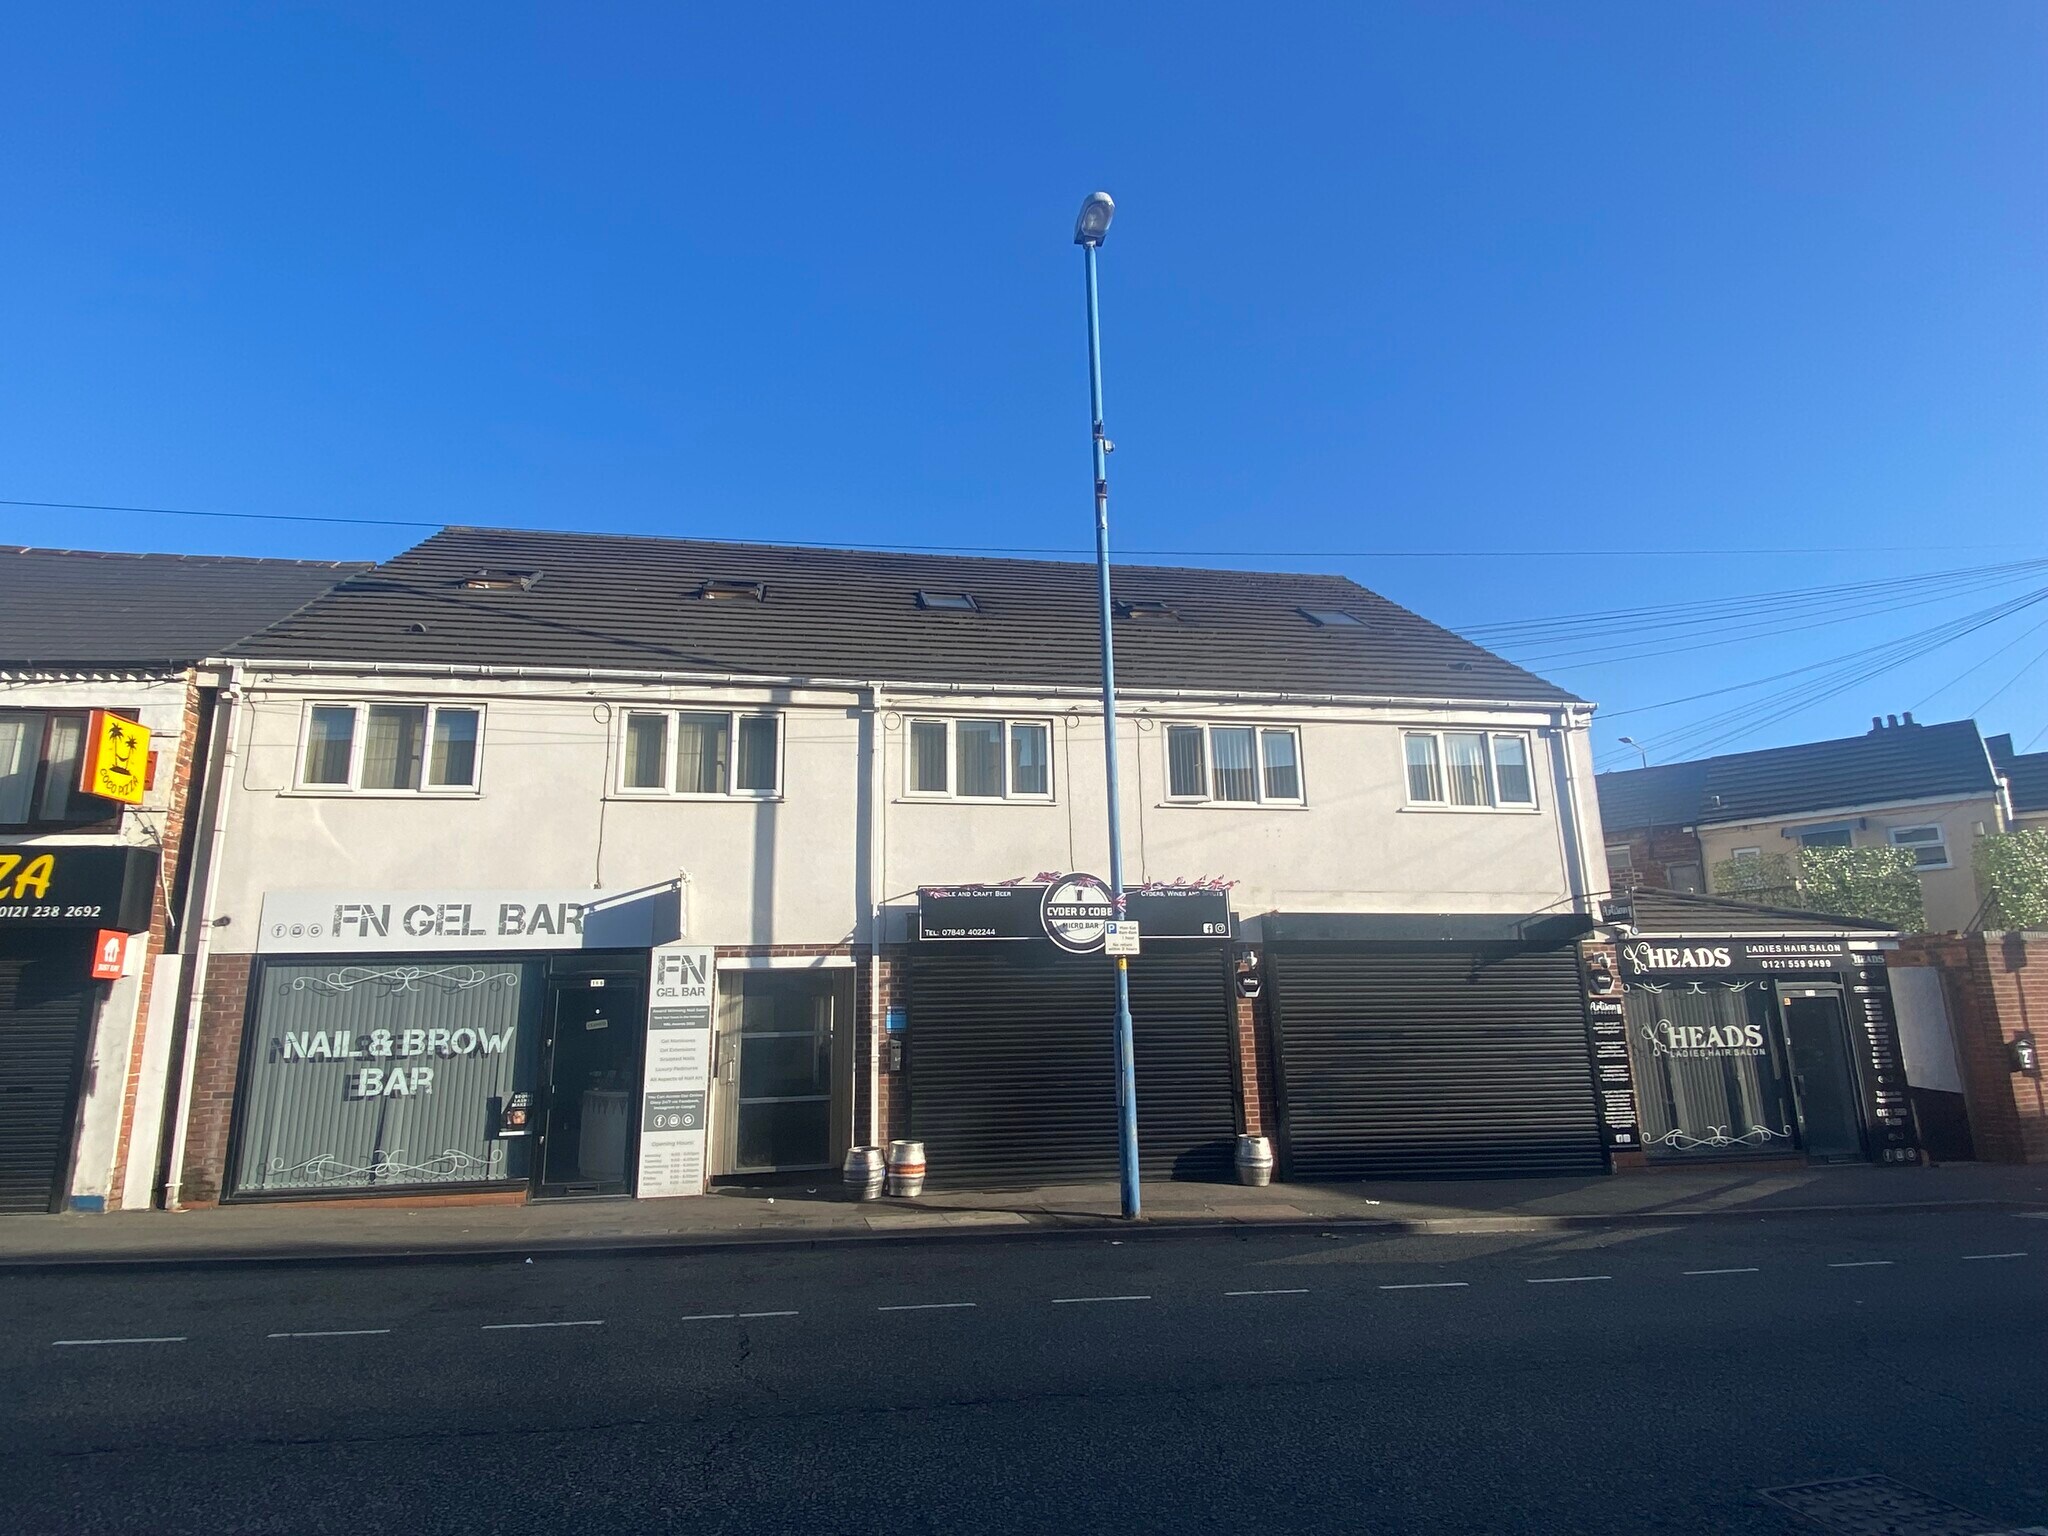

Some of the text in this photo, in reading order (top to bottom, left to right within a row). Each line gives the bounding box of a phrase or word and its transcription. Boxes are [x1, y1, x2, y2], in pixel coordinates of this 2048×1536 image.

[100, 768, 139, 796] COCO PIZZA
[0, 905, 101, 918] 0121 238 2692
[1046, 906, 1077, 917] CYDER
[1079, 906, 1087, 917] &
[332, 902, 585, 937] FN GEL BAR
[1063, 921, 1099, 930] MICRO BAR
[941, 928, 966, 937] 07849
[967, 928, 996, 936] 402244
[1746, 943, 1841, 954] LADIES HAIR SALON
[1648, 947, 1732, 969] HEADS
[1762, 959, 1832, 969] 0121 559 9499
[657, 954, 707, 985] FN
[656, 986, 706, 998] GEL BAR
[283, 1026, 515, 1059] NAIL & BROW
[1668, 1024, 1763, 1049] HEADS
[1670, 1048, 1766, 1058] LADIES HAIR SALON
[357, 1066, 435, 1097] BAR
